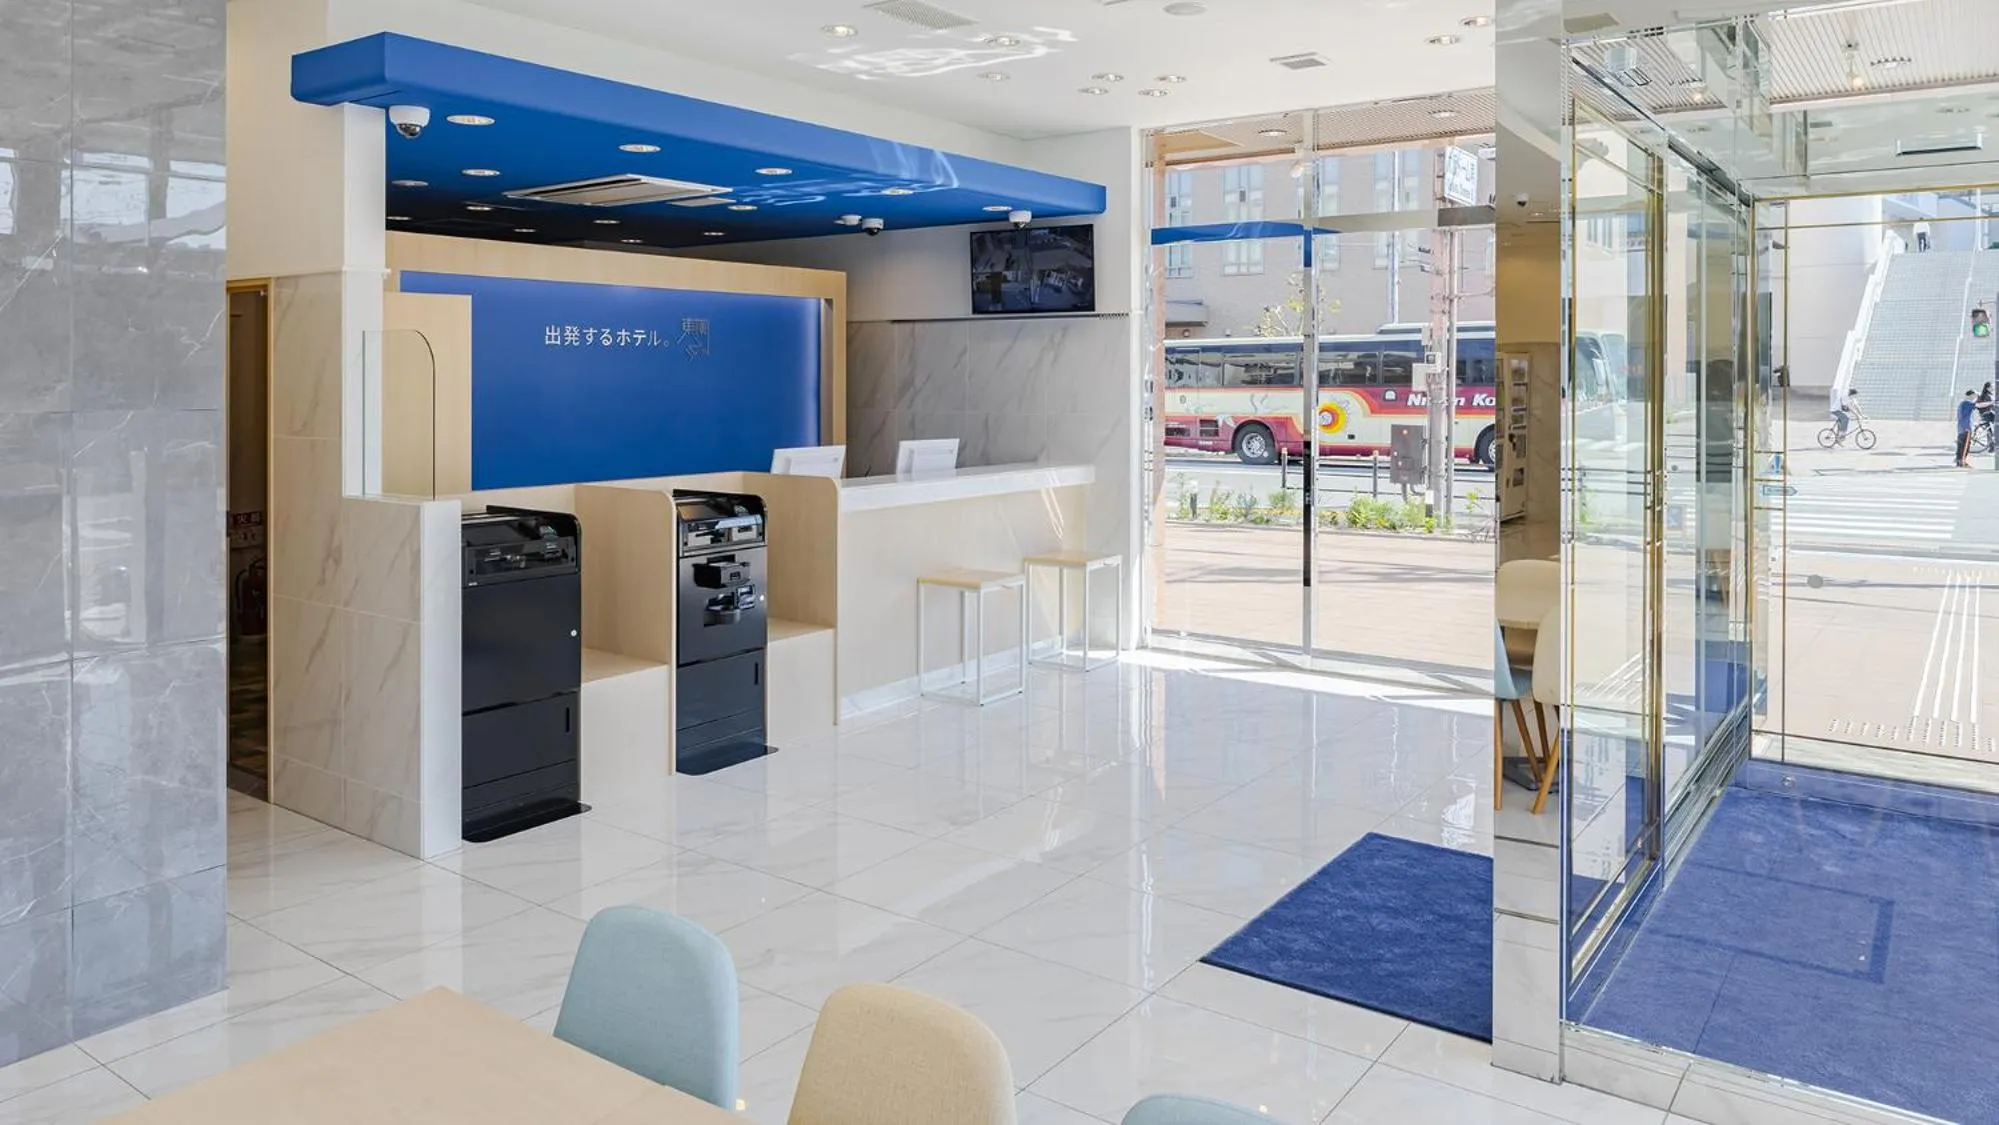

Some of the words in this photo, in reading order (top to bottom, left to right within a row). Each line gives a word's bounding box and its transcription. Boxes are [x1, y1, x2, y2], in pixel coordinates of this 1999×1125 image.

[544, 325, 670, 347] 出発するホテル。
[1407, 393, 1466, 406] Nin
